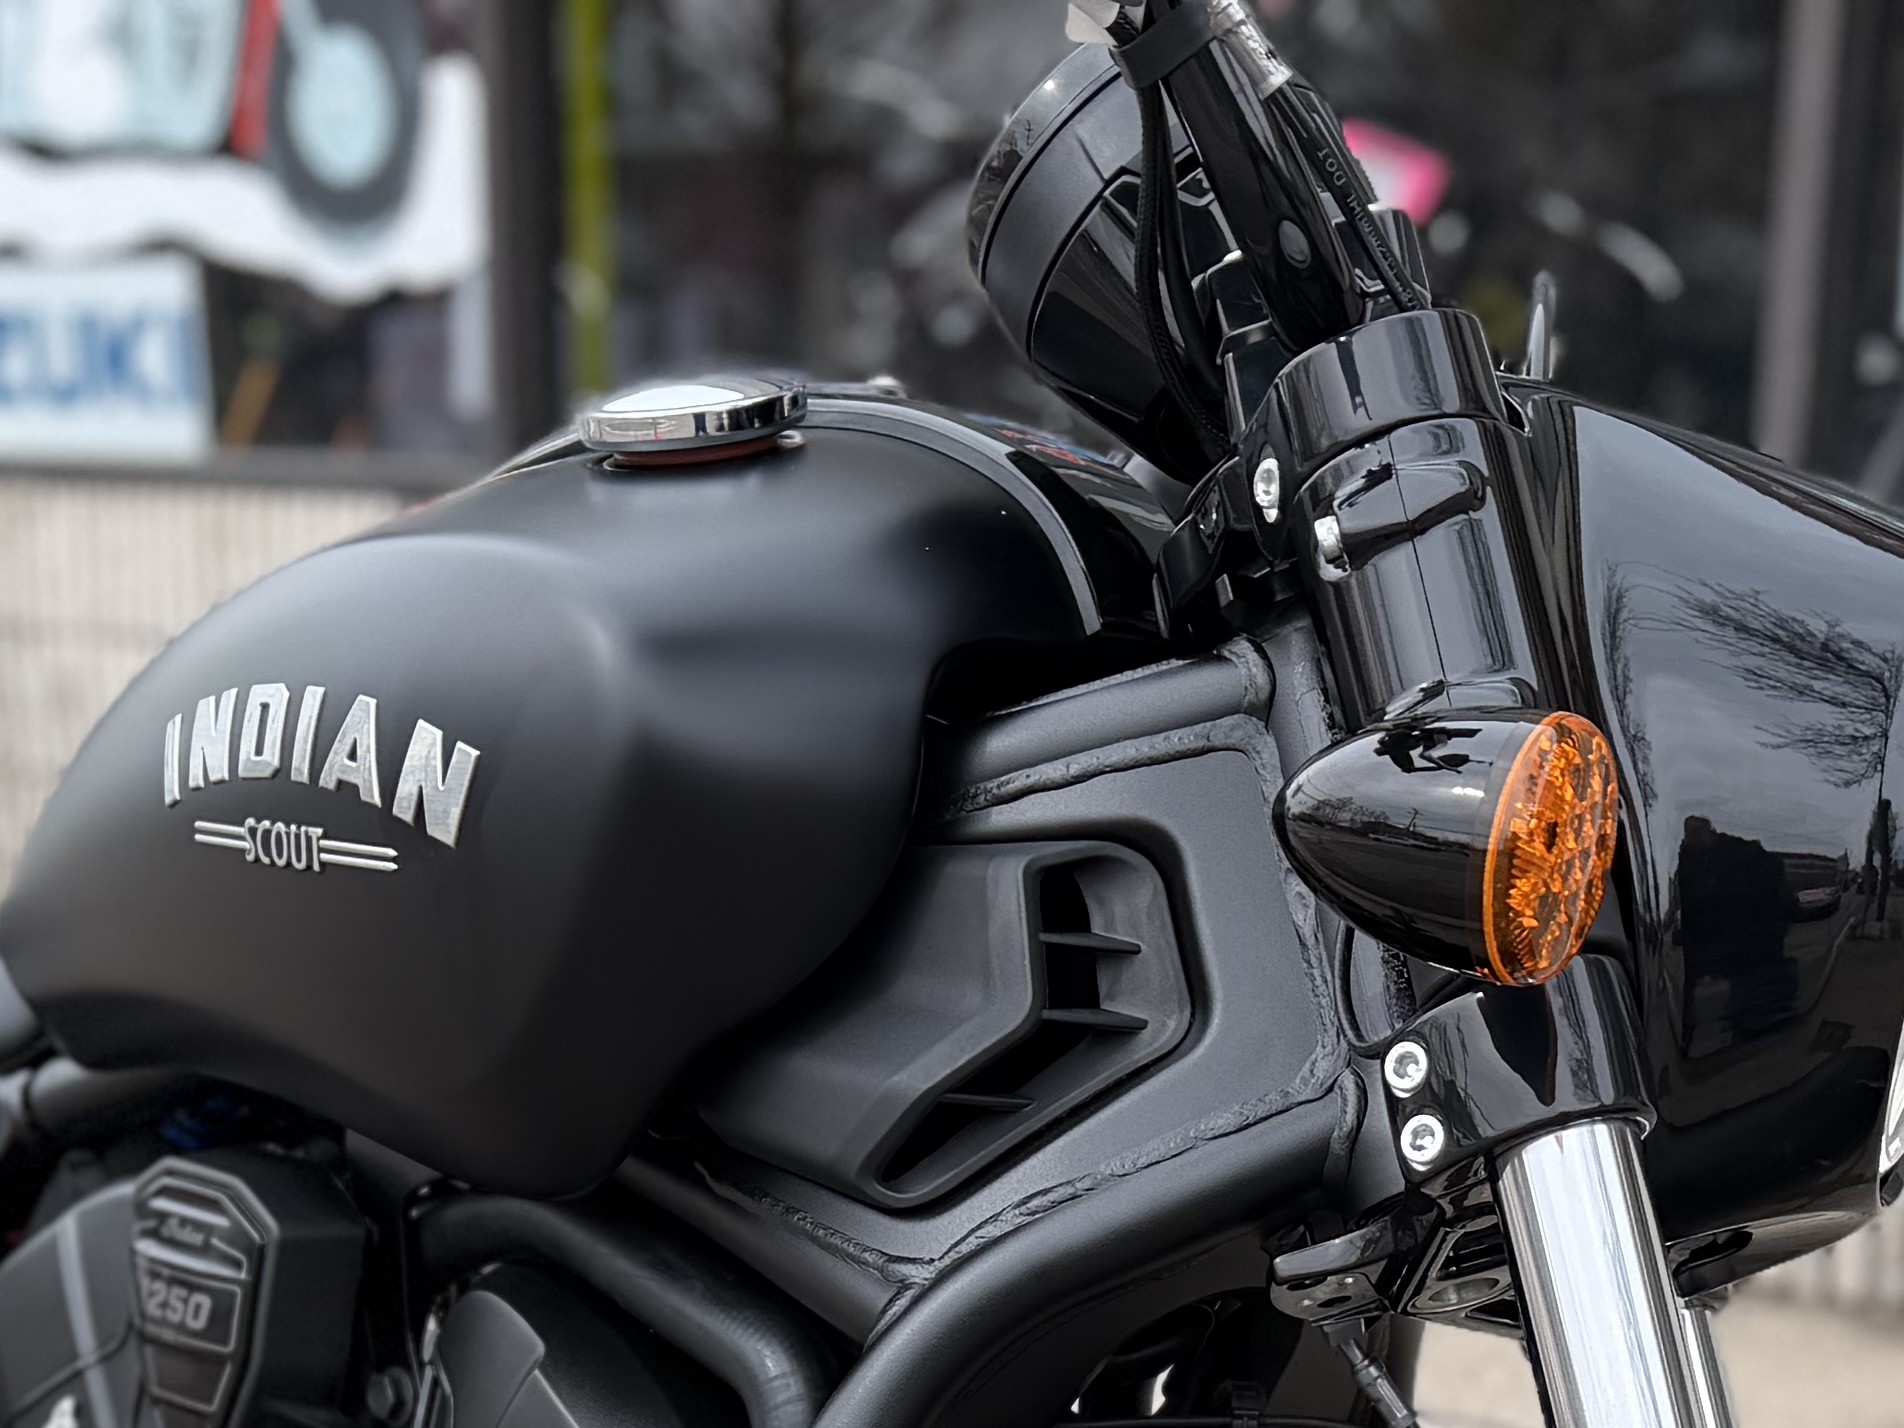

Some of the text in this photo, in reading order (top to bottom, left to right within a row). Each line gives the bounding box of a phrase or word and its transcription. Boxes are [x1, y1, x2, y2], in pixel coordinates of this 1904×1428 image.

[1317, 147, 1348, 190] DOT
[163, 682, 480, 849] INDIAN
[244, 817, 323, 872] SCOUT
